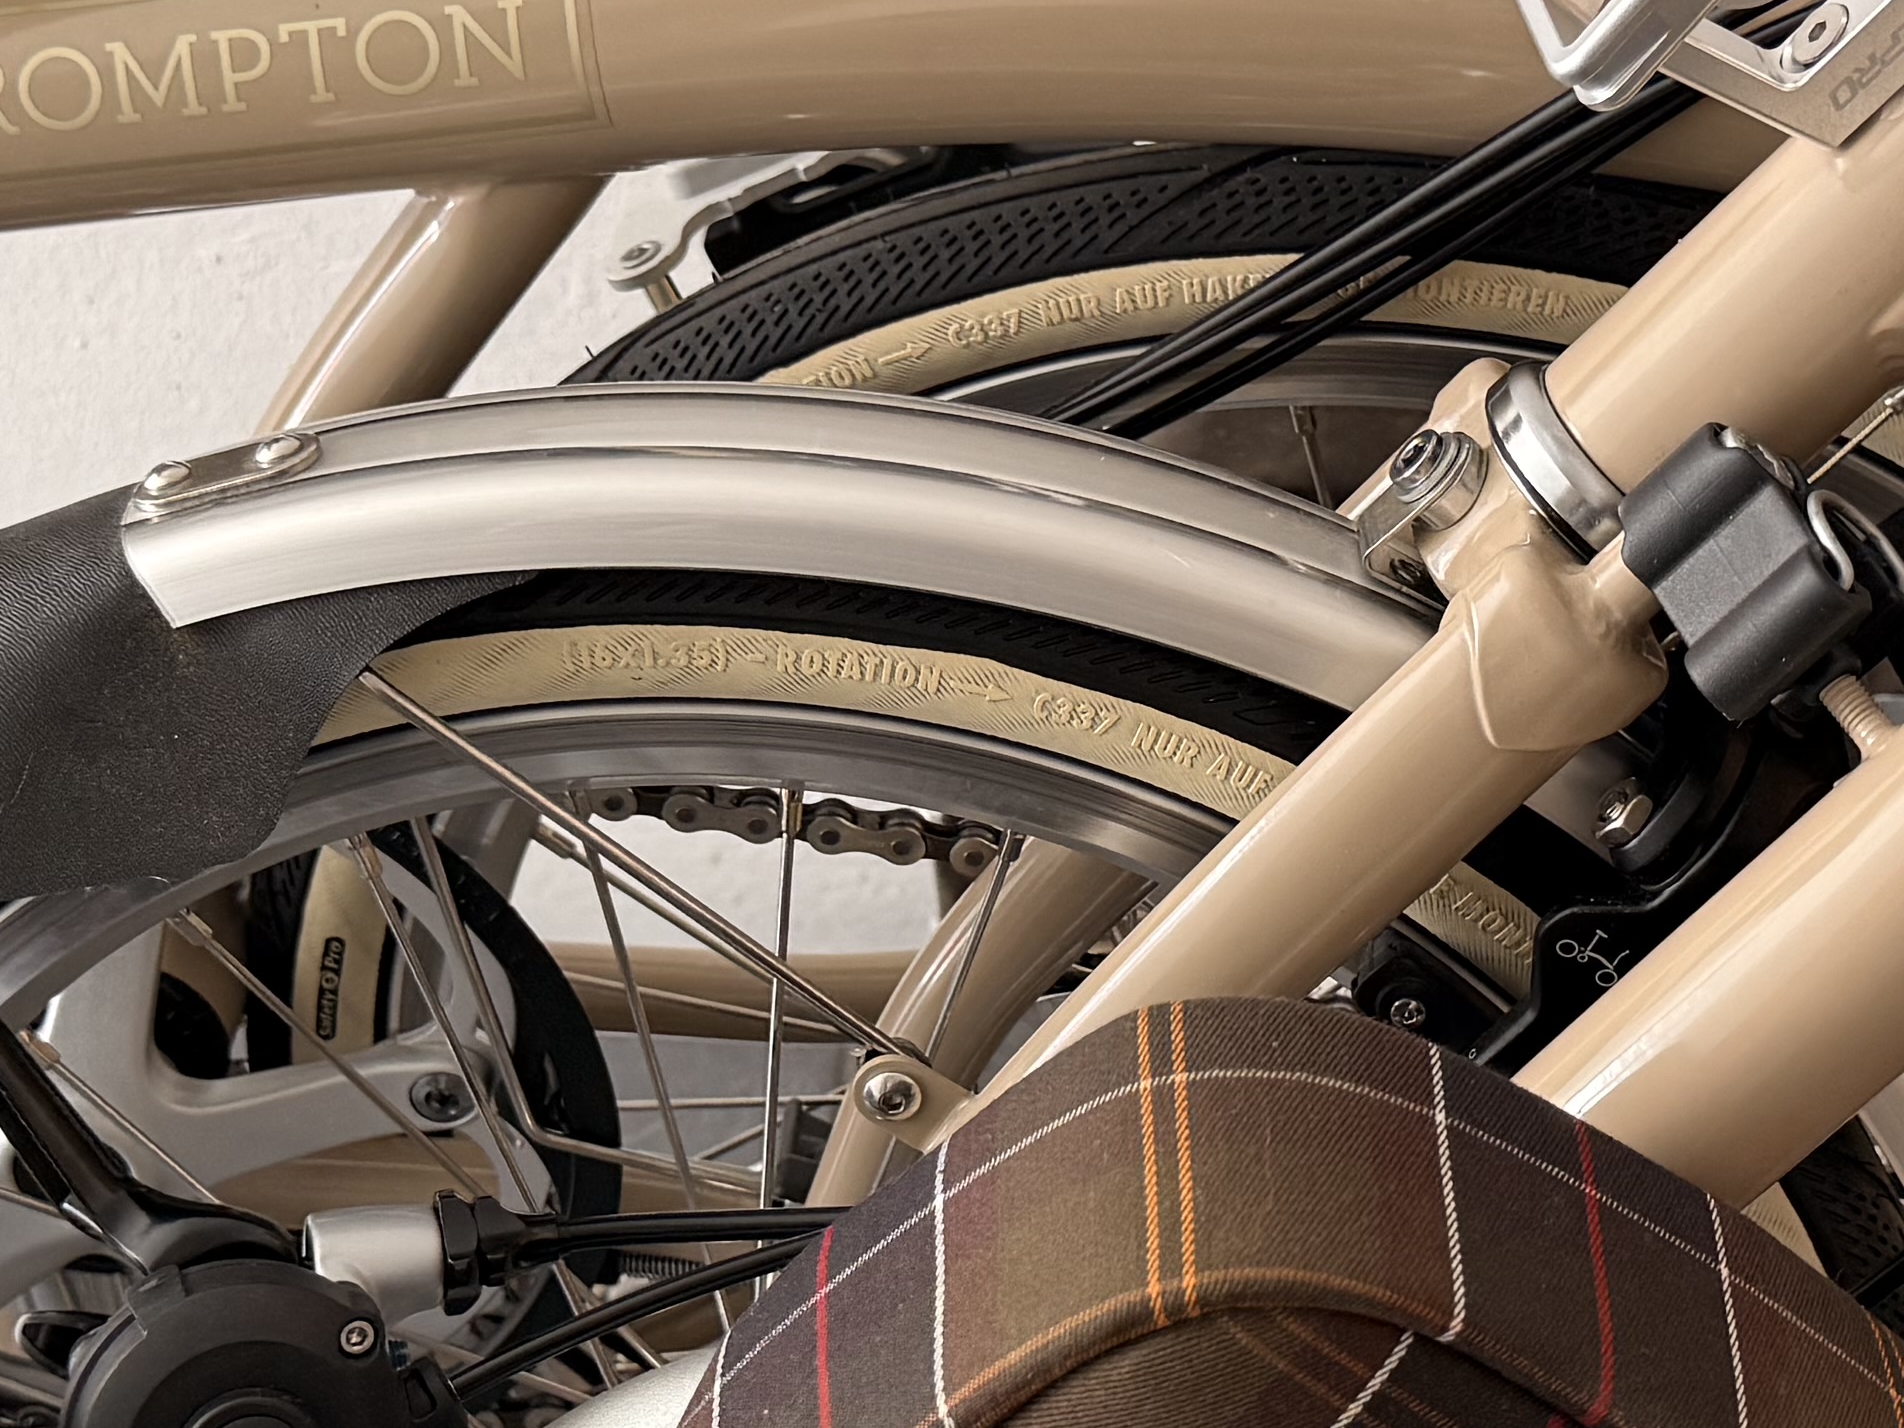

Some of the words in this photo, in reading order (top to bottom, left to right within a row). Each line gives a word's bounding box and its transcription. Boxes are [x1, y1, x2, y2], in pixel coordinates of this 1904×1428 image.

[948, 309, 1021, 350] C337
[1042, 291, 1102, 328] NUR
[1114, 280, 1174, 315] AUF
[776, 644, 943, 695] ROTATION
[1033, 691, 1121, 737] C337
[1130, 722, 1203, 769] NUR
[1206, 752, 1275, 796] AUF
